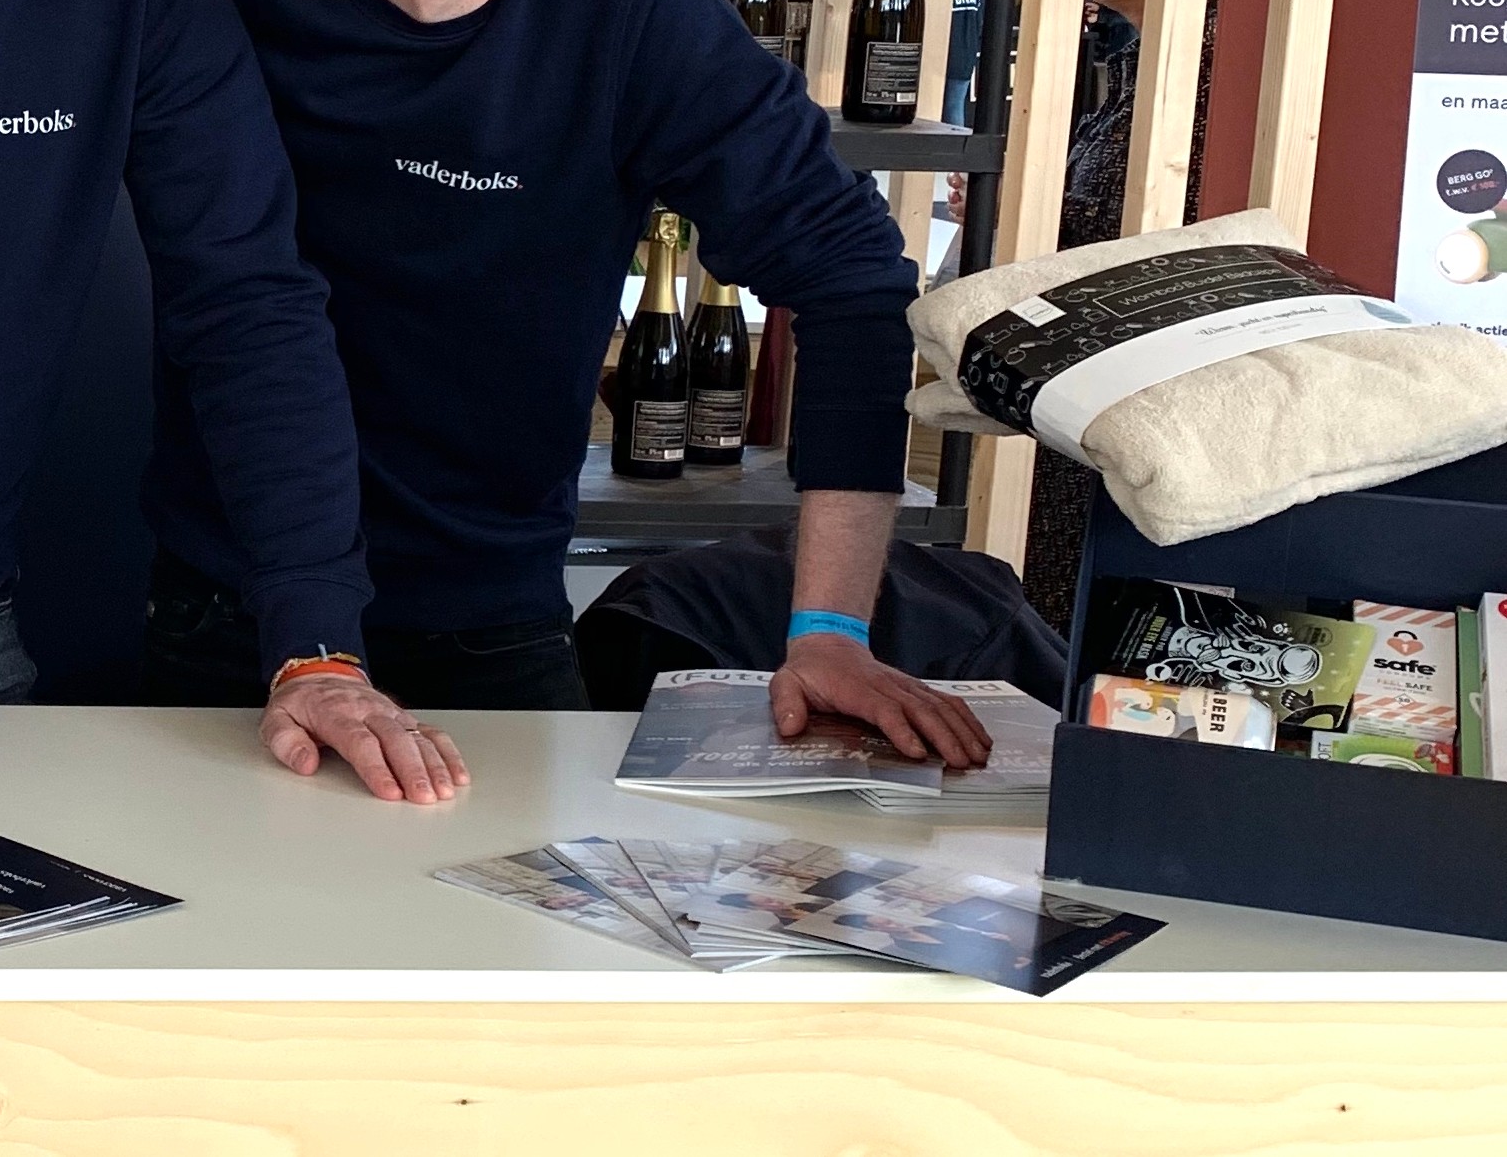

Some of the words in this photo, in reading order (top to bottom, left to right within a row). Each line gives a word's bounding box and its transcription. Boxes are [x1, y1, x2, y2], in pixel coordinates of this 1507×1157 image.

[1442, 96, 1464, 109] en
[1447, 173, 1474, 185] BERG
[1373, 658, 1436, 676] safe
[1405, 682, 1434, 692] SAFE
[1210, 698, 1227, 733] BEER
